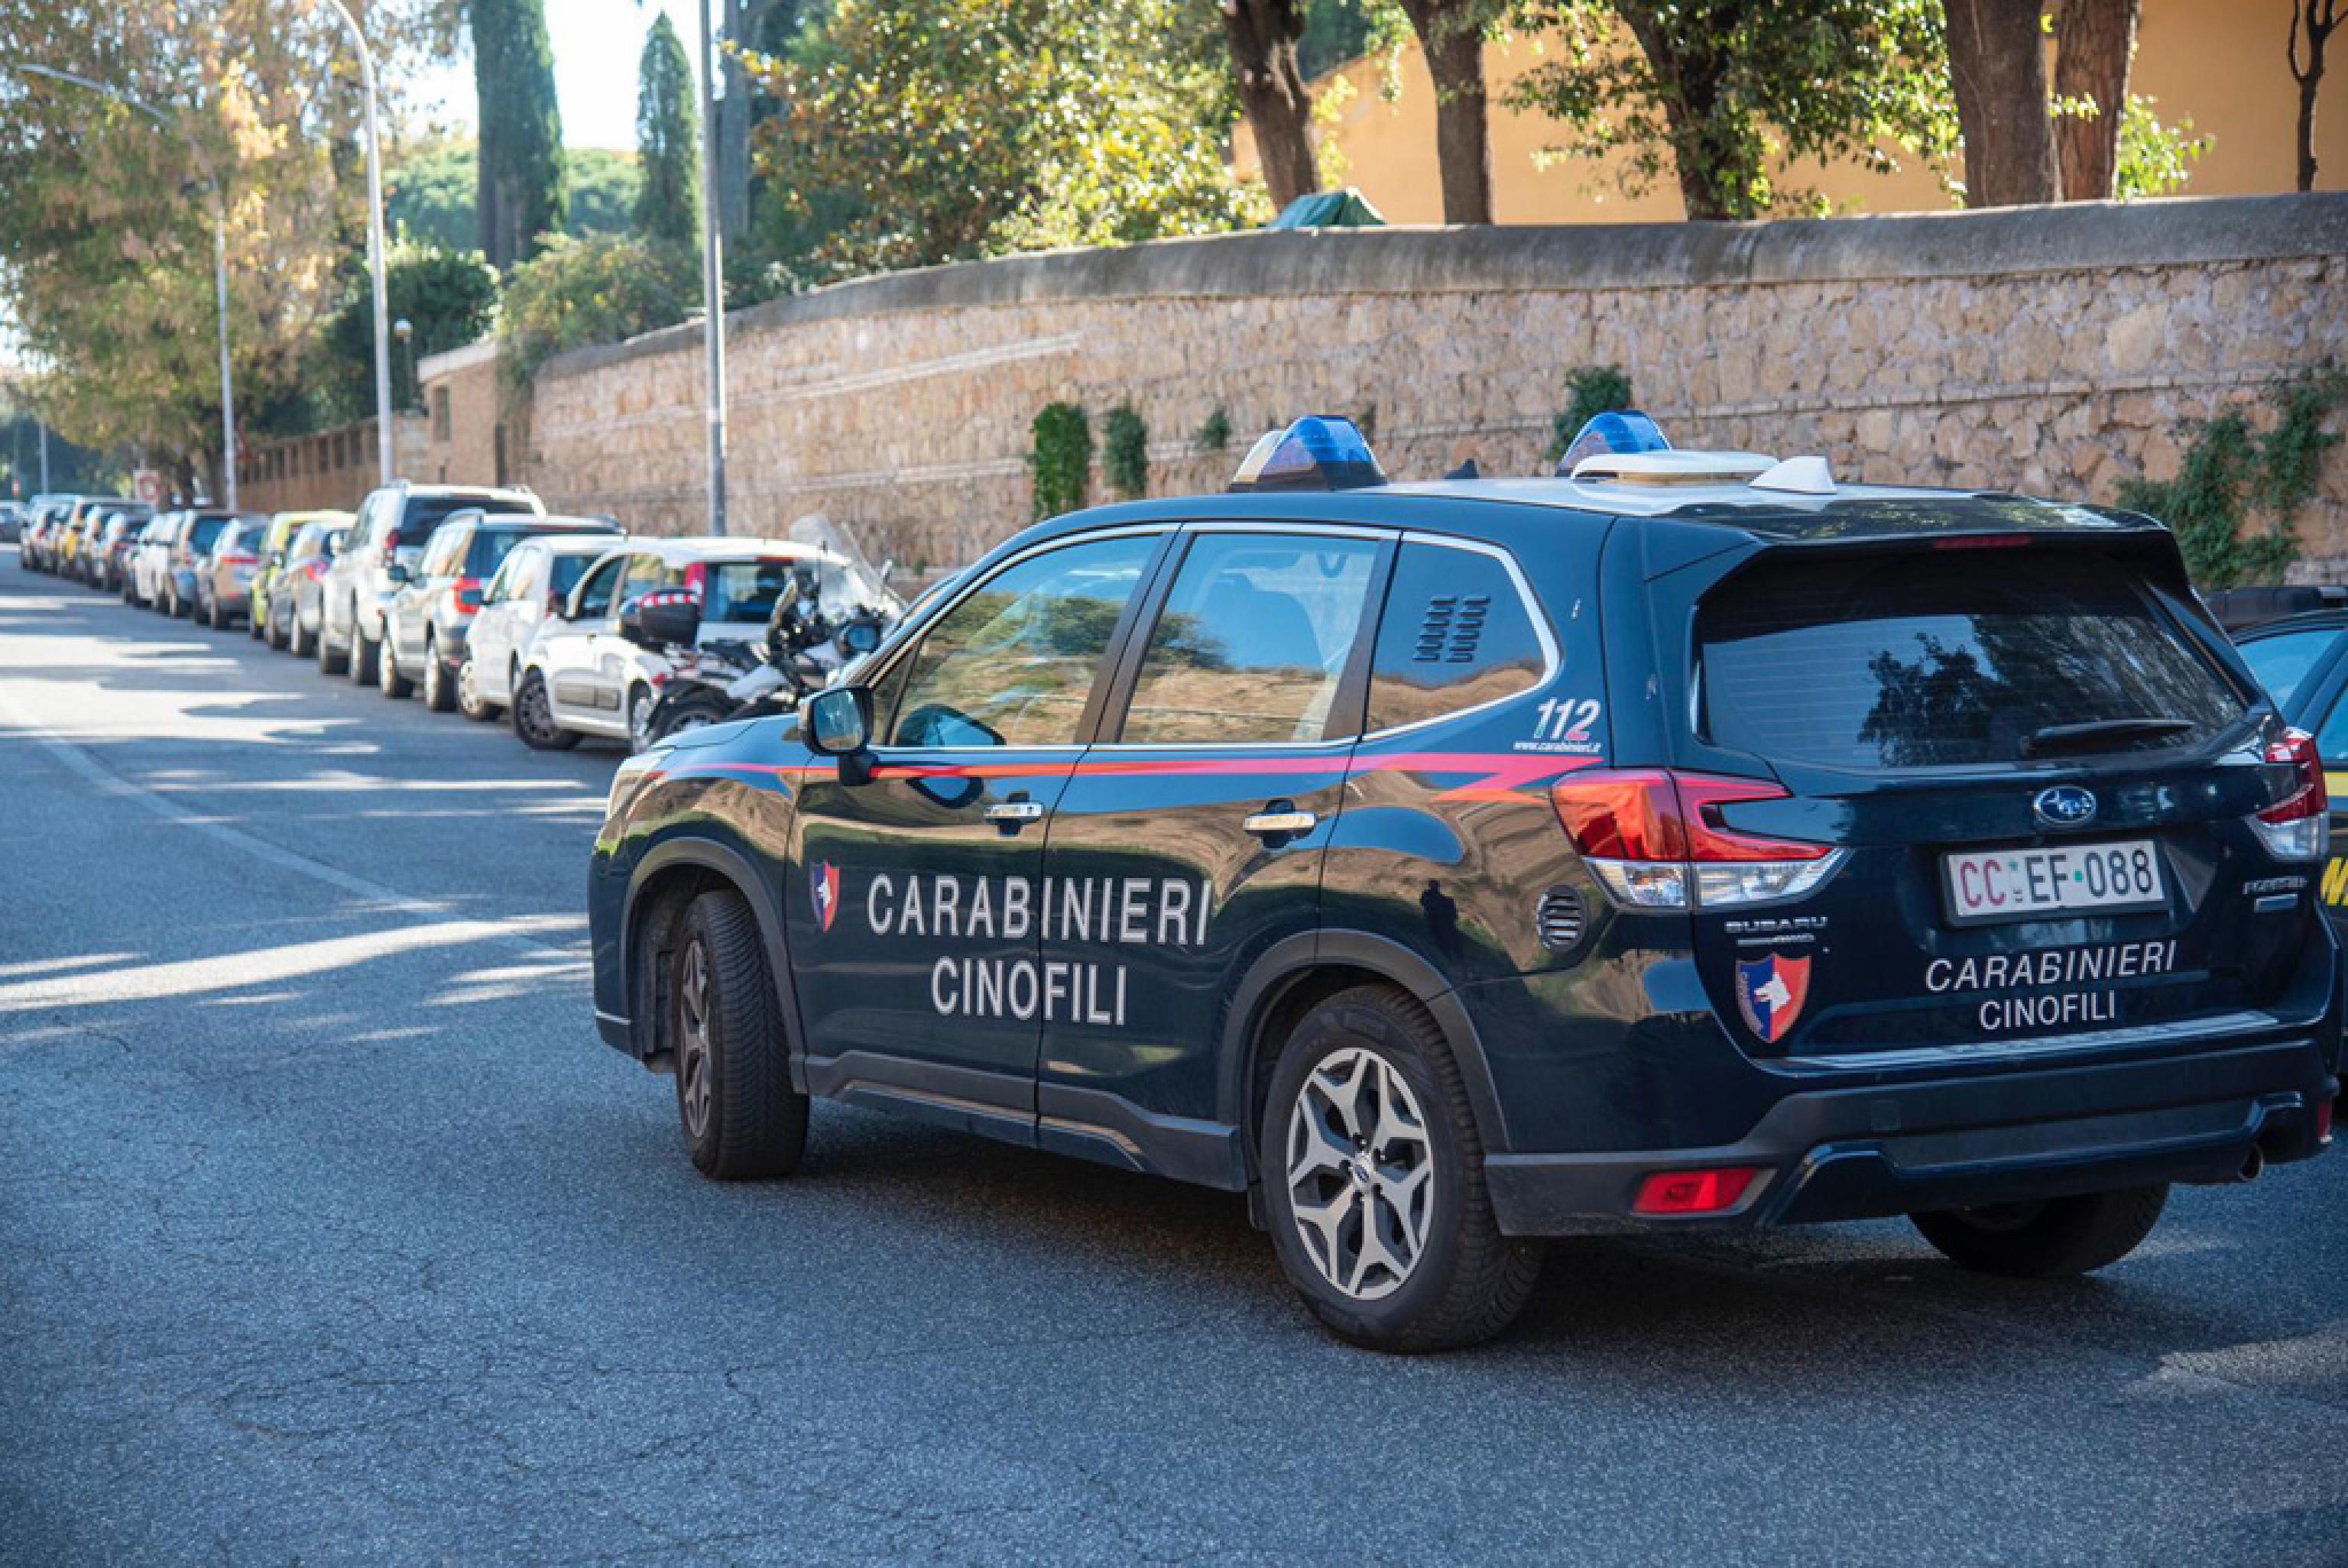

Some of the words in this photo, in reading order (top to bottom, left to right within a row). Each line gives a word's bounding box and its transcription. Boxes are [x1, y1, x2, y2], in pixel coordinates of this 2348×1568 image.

[1533, 697, 1601, 740] 112
[1959, 859, 2006, 908] CC
[2025, 854, 2068, 903] EF
[2084, 848, 2154, 899] 088
[867, 873, 1212, 945] CARABINIERI
[931, 957, 1127, 1025] CINOFILI
[1925, 939, 2177, 992] CARABINIERI
[1978, 990, 2115, 1030] CINOFILI
